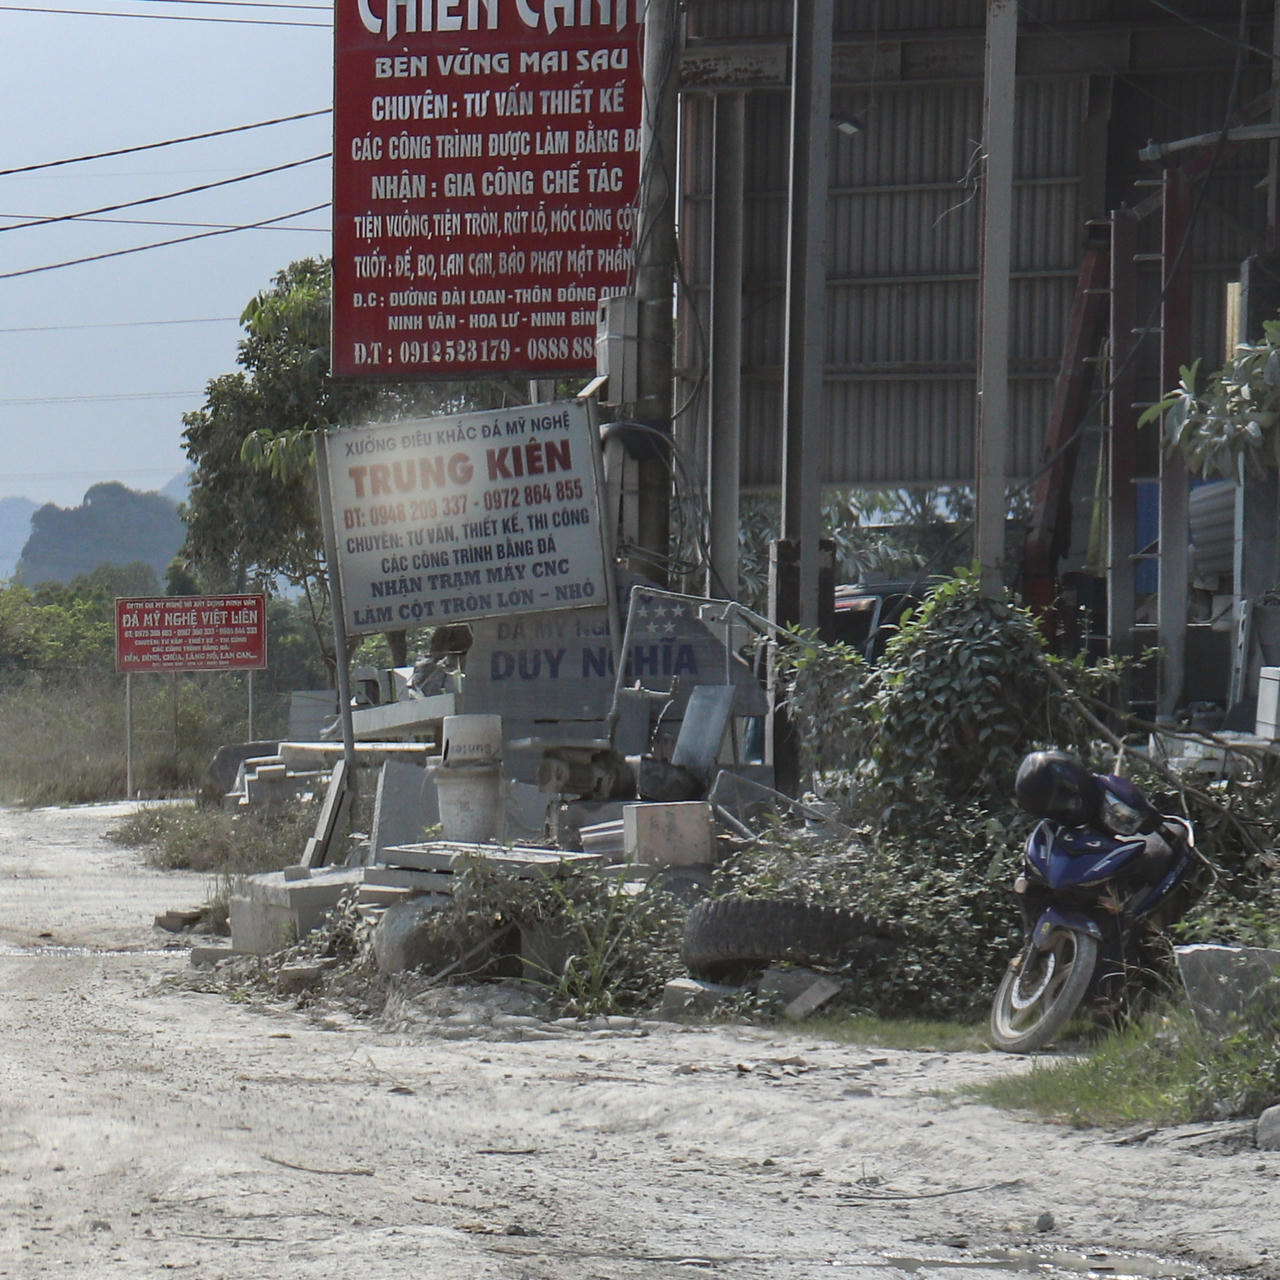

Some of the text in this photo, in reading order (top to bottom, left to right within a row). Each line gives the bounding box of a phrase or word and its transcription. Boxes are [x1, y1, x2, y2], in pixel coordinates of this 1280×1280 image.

[437, 48, 510, 76] VỮNG
[520, 50, 569, 75] MAI
[576, 48, 629, 73] SAU
[464, 90, 490, 118] TƯ
[494, 82, 534, 117] VẤN
[540, 80, 594, 115] THIẾT
[599, 78, 627, 113] KẾ
[351, 131, 383, 161] CÁC
[388, 130, 432, 160] CÔNG
[435, 128, 483, 159] TRÌNH
[488, 130, 531, 161] ĐƯỢC
[535, 125, 569, 155] LÀM
[575, 120, 619, 154] BẰNG
[444, 173, 476, 198] GIA
[482, 165, 535, 197] CÔNG
[542, 160, 581, 195] CHẾ
[587, 161, 624, 193] TÁC
[354, 209, 383, 244] TIỆN
[433, 207, 461, 242] TIỆN
[504, 204, 529, 237] RÚT
[550, 203, 577, 233] MÓC
[440, 251, 465, 278] LAN
[498, 244, 525, 277] BÀO
[530, 250, 564, 276] PHAY
[597, 235, 637, 273] PHẲN
[389, 286, 438, 307] ĐƯỜNG
[442, 286, 466, 306] ĐÀI
[515, 285, 553, 304] THÔN
[388, 307, 597, 331] NINH VÂN HOA LƯ NINH BÌN
[344, 433, 397, 457] XƯỞNG
[436, 420, 478, 446] KHẮC
[481, 418, 503, 440] ĐÁ
[506, 416, 527, 437] MỸ
[531, 410, 571, 432] NGHỆ
[348, 436, 573, 498] TRUNG KIÊN
[441, 493, 469, 517] 337
[483, 486, 521, 512] 0972
[524, 482, 553, 507] 864
[555, 478, 584, 502] 855
[406, 527, 425, 548] TƯ
[461, 515, 499, 541] THIẾT
[527, 512, 549, 532] THI
[552, 506, 590, 529] CÔNG
[381, 553, 410, 575] CÁC
[412, 549, 450, 571] CÔNG
[452, 543, 494, 566] TRÌNH
[537, 532, 558, 555] ĐÁ
[370, 558, 570, 598] NHẬN TRẠM MÁY CNC
[122, 607, 258, 629] ĐÁ MỸ NGHỆ VIỆT LIÊN
[352, 603, 395, 627] LÀM
[398, 599, 436, 623] CỘT
[441, 592, 493, 616] TRÒN
[496, 586, 536, 609] LỚN
[554, 577, 596, 602] NHỎ
[490, 646, 568, 681] DUY
